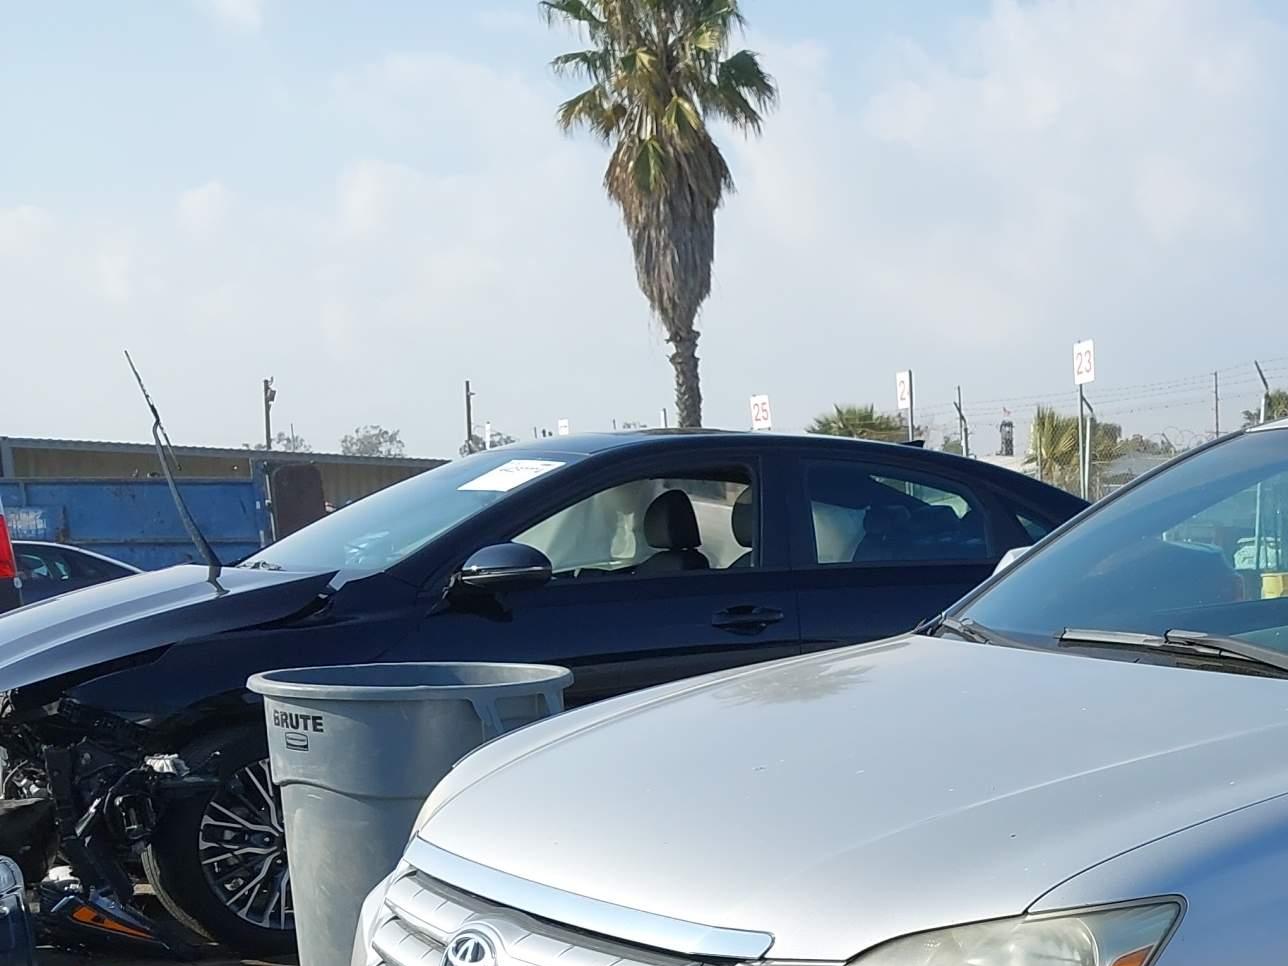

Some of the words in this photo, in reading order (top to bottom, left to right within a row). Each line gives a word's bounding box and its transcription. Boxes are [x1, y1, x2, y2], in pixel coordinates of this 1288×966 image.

[1076, 350, 1092, 375] 23
[753, 402, 769, 421] 25
[273, 709, 324, 733] BRUTE
